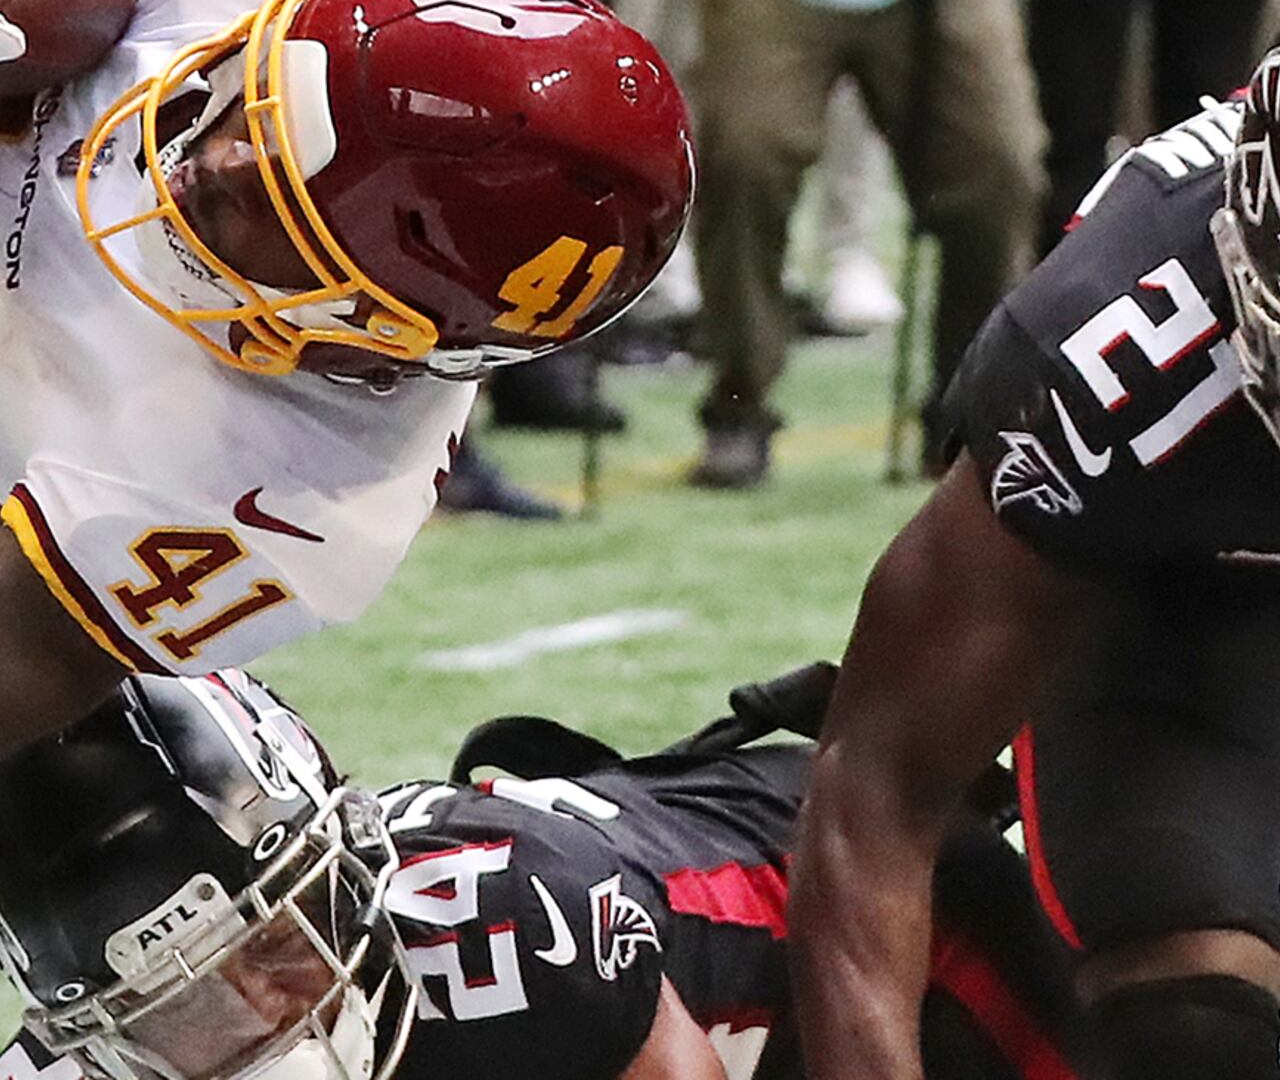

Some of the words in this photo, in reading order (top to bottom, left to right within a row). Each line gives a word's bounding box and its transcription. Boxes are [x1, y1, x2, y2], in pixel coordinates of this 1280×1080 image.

[489, 234, 626, 340] 41
[1058, 257, 1247, 468] 21
[106, 525, 298, 664] 41
[135, 902, 200, 953] ATL
[382, 836, 529, 1022] 24
